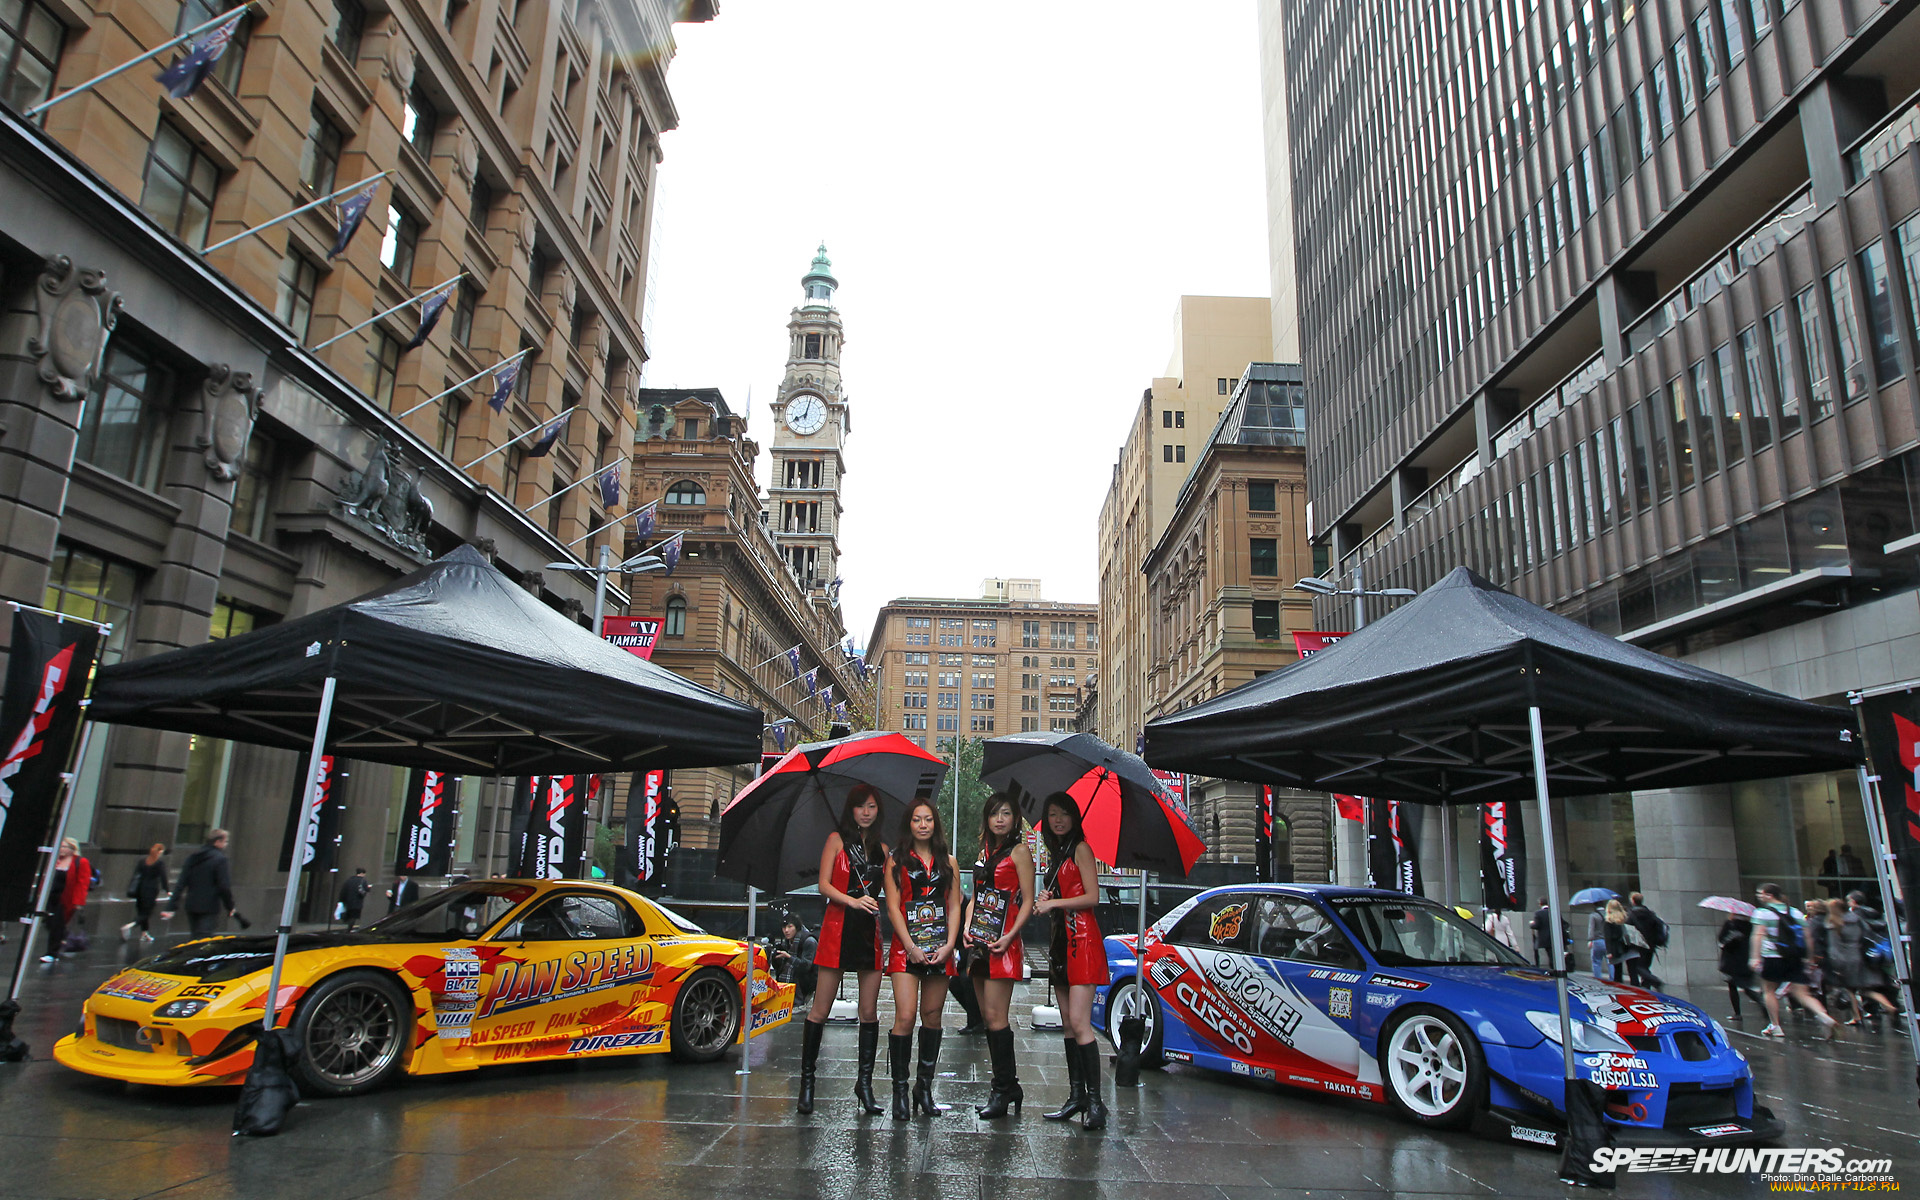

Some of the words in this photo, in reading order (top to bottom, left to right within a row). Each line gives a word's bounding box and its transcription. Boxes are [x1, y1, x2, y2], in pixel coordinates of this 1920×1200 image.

[1403, 860, 1414, 896] OHAMA
[445, 962, 479, 977] HKS
[1307, 969, 1330, 980] TEAM
[1328, 971, 1361, 984] TARZAN
[476, 960, 562, 1020] PAN
[560, 943, 654, 992] SPEED
[587, 982, 616, 993] Technology
[1371, 977, 1420, 989] ADVAN
[177, 985, 227, 997] GCG
[766, 1008, 790, 1025] GIKEN
[1176, 982, 1254, 1056] CUSCO
[1200, 984, 1257, 1038] www.cusco.co.jp
[567, 1030, 666, 1053] DIREZZA
[1164, 1051, 1190, 1062] ADVAN
[1590, 1070, 1630, 1087] CUSCO
[1632, 1072, 1660, 1088] L.S.D.
[1323, 1080, 1357, 1095] TAKATA
